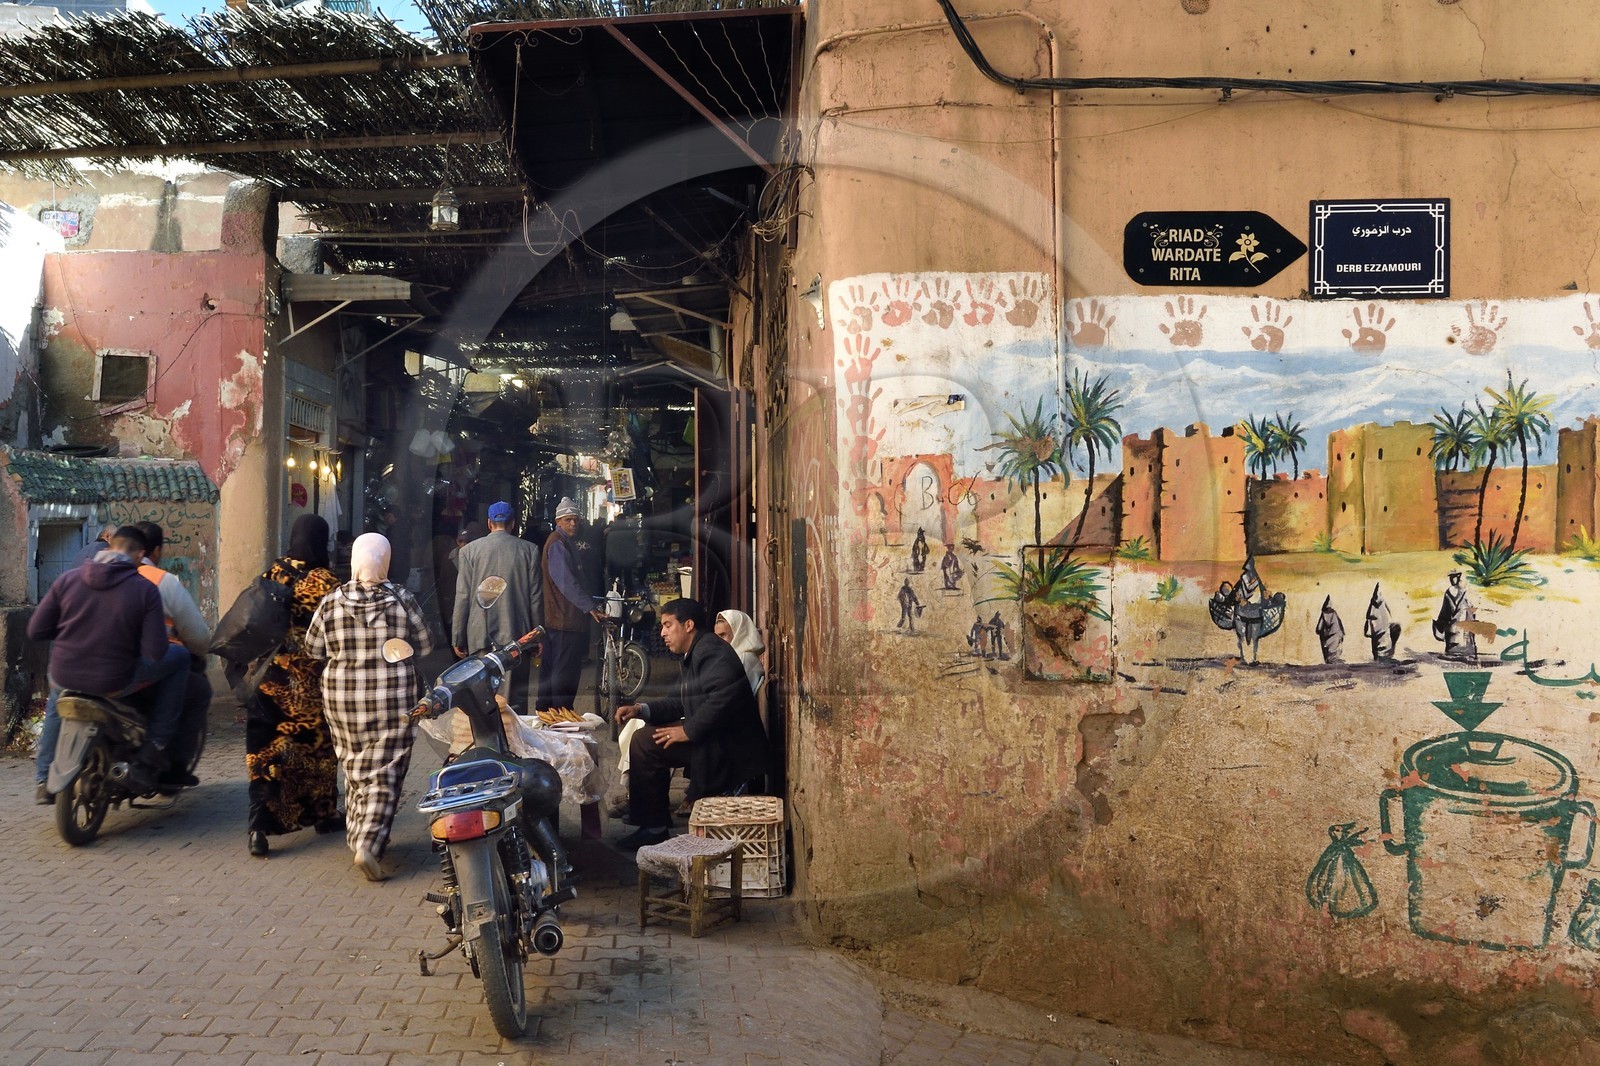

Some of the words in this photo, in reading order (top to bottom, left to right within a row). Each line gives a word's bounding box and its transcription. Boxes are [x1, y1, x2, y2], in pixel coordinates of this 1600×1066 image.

[1168, 228, 1205, 243] RIAD
[1351, 224, 1390, 238] الزموري
[1391, 225, 1412, 237] درب
[1151, 247, 1222, 262] WARDATE
[1169, 267, 1202, 281] RITA
[1336, 263, 1363, 273] DERB
[1363, 262, 1422, 273] EZZAMOURI
